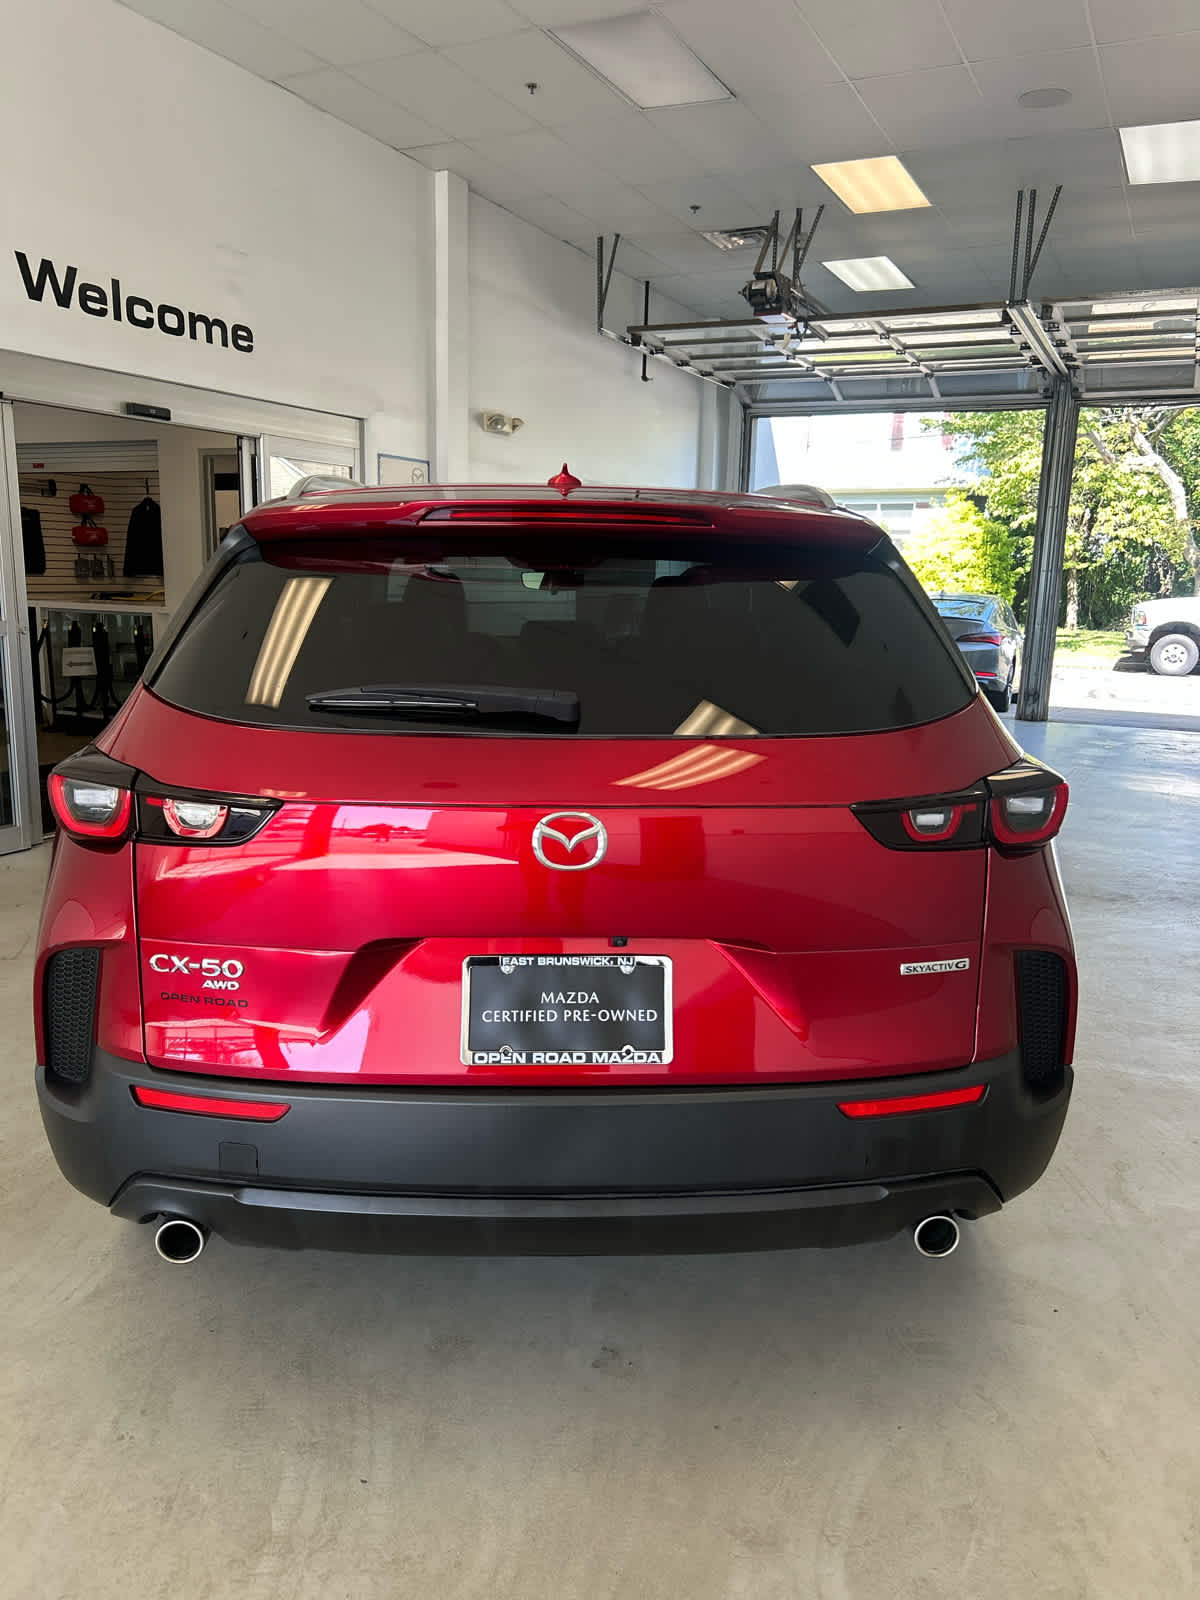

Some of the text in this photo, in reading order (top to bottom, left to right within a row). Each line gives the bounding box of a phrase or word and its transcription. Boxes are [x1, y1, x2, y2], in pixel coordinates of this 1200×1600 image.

[14, 250, 254, 353] Welcome
[149, 953, 244, 978] CX-50
[502, 957, 535, 966] EAST
[617, 957, 634, 966] NJ
[201, 980, 240, 991] AWD
[160, 991, 249, 1008] OPEN ROAD
[541, 992, 599, 1004] MAZDA
[481, 1009, 658, 1022] CERTIFIED PRE-OWNED
[474, 1052, 661, 1064] OPEN ROAD MAZDA
